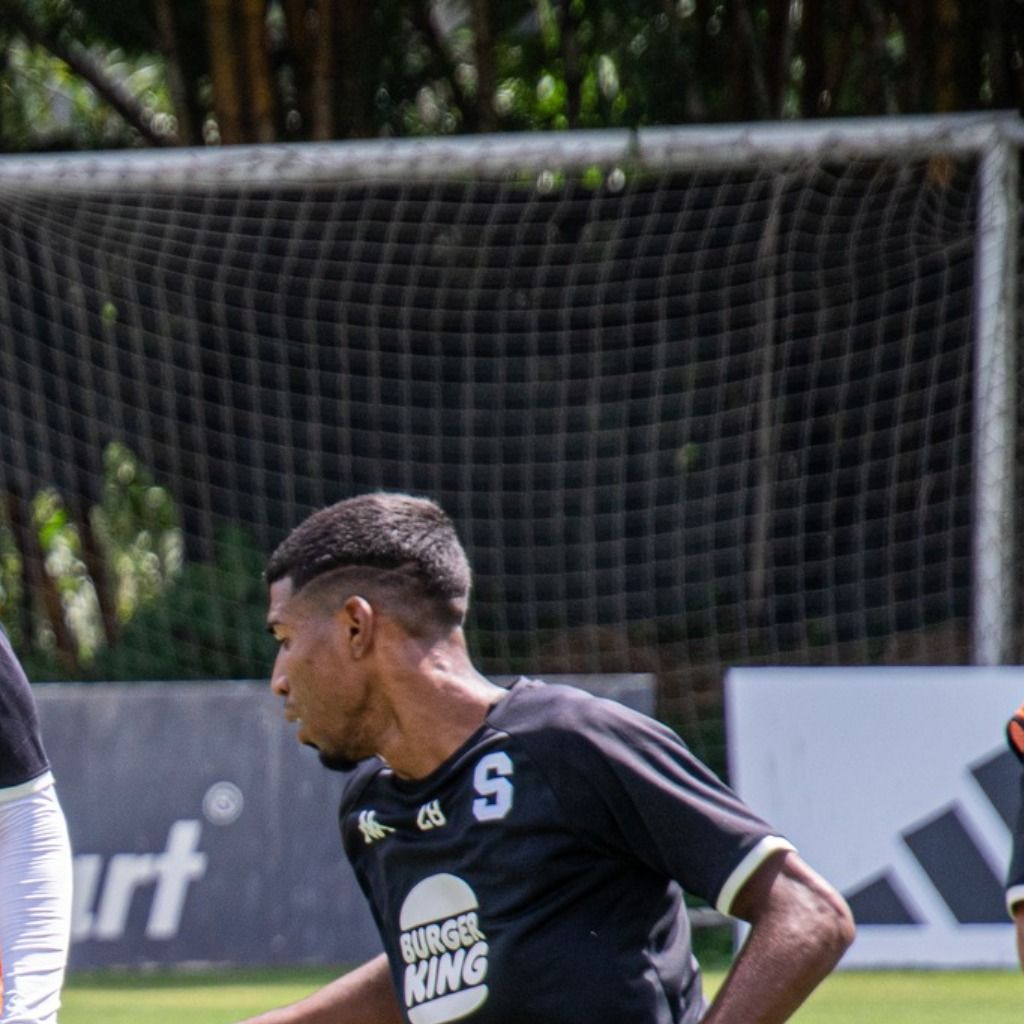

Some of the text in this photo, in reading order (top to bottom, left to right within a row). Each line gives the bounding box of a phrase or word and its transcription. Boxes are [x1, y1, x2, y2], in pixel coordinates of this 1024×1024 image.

[472, 750, 514, 822] S
[399, 911, 486, 965] BURGER
[404, 940, 489, 1008] KING
